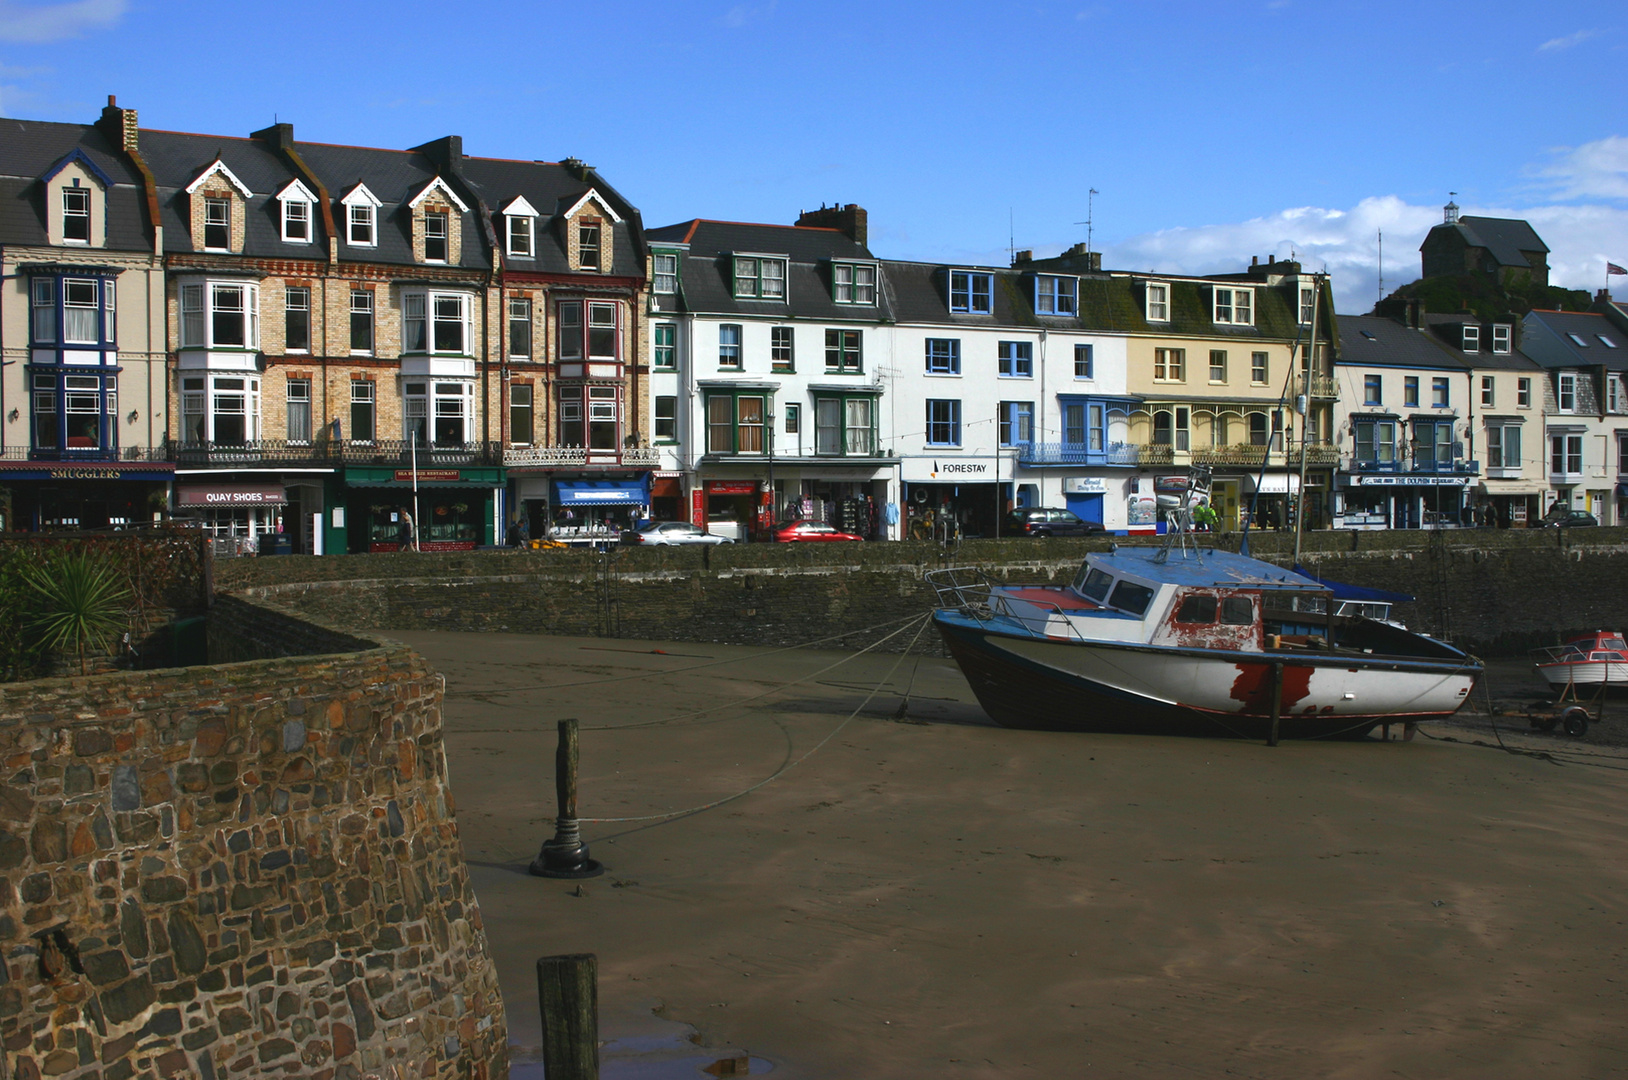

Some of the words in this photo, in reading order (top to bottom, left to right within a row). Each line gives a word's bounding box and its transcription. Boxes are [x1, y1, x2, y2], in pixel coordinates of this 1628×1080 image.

[943, 464, 986, 473] FORESTAY
[51, 470, 121, 479] SMUGGLERS
[206, 493, 232, 502] QUAY
[233, 493, 263, 501] SHOES
